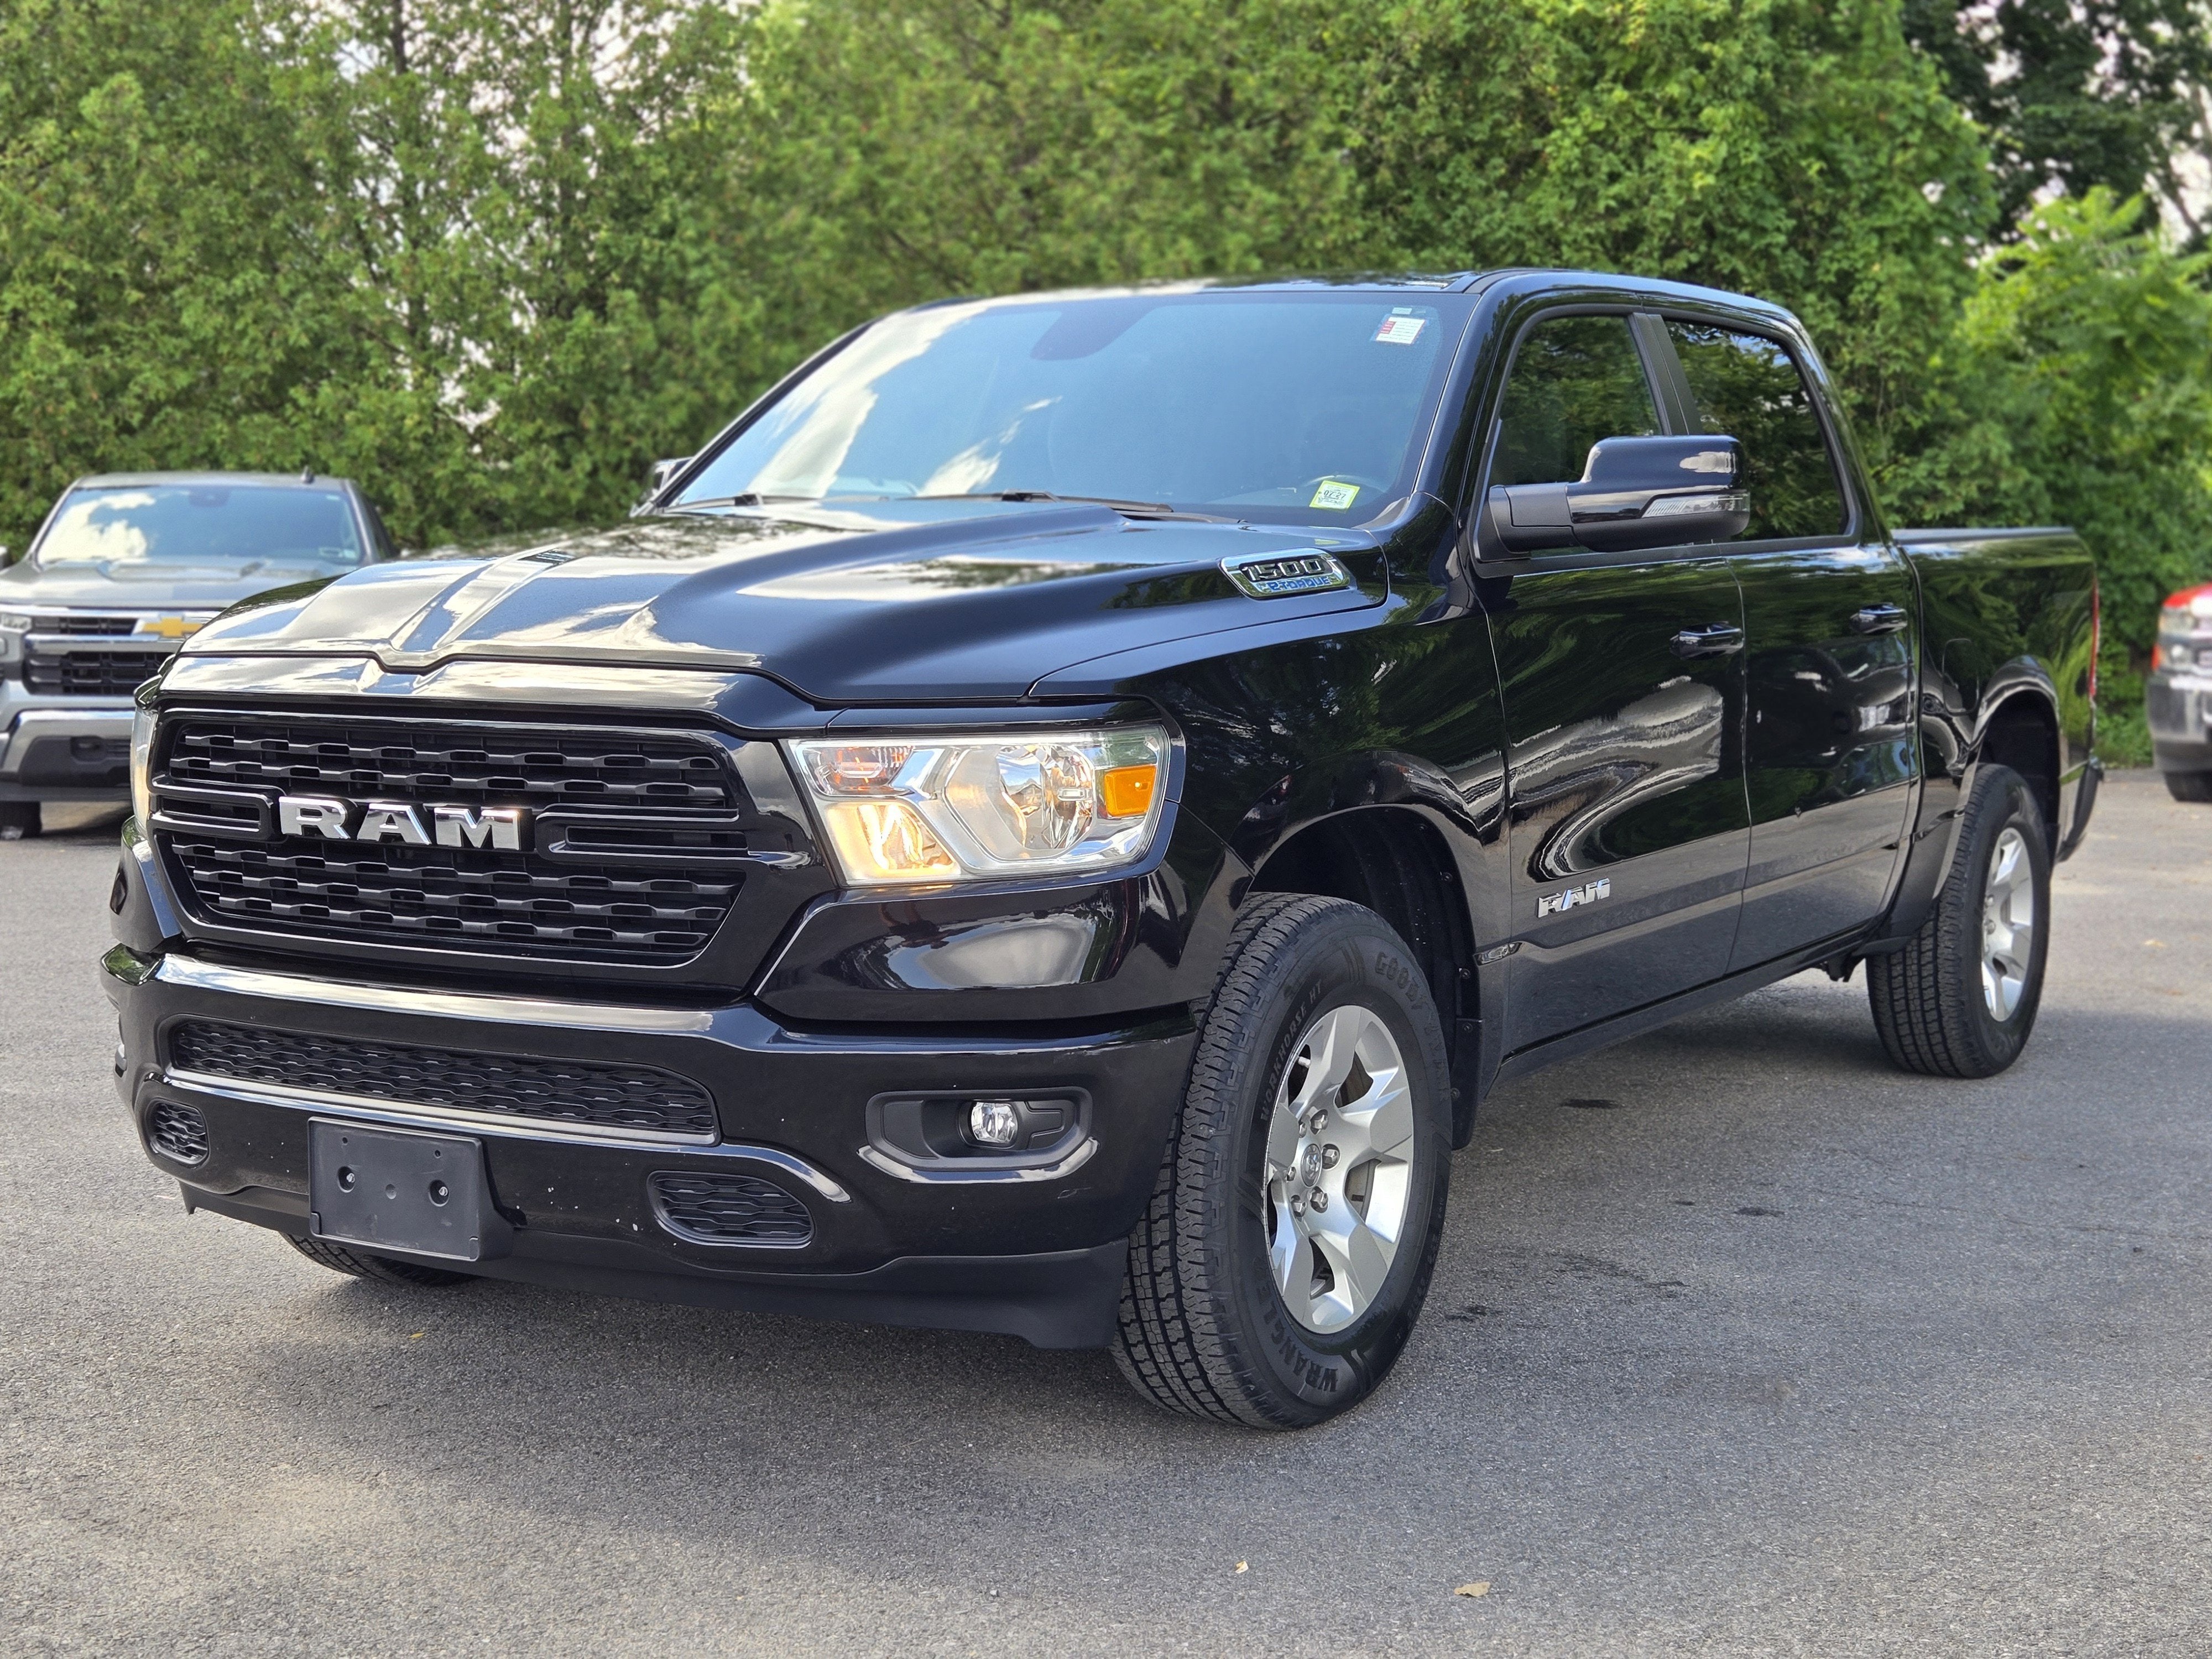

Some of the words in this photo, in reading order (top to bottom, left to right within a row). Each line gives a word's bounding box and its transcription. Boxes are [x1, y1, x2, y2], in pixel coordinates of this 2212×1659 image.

[1241, 559, 1325, 581] 1500
[278, 796, 520, 851] RAM
[1536, 878, 1610, 918] RAM
